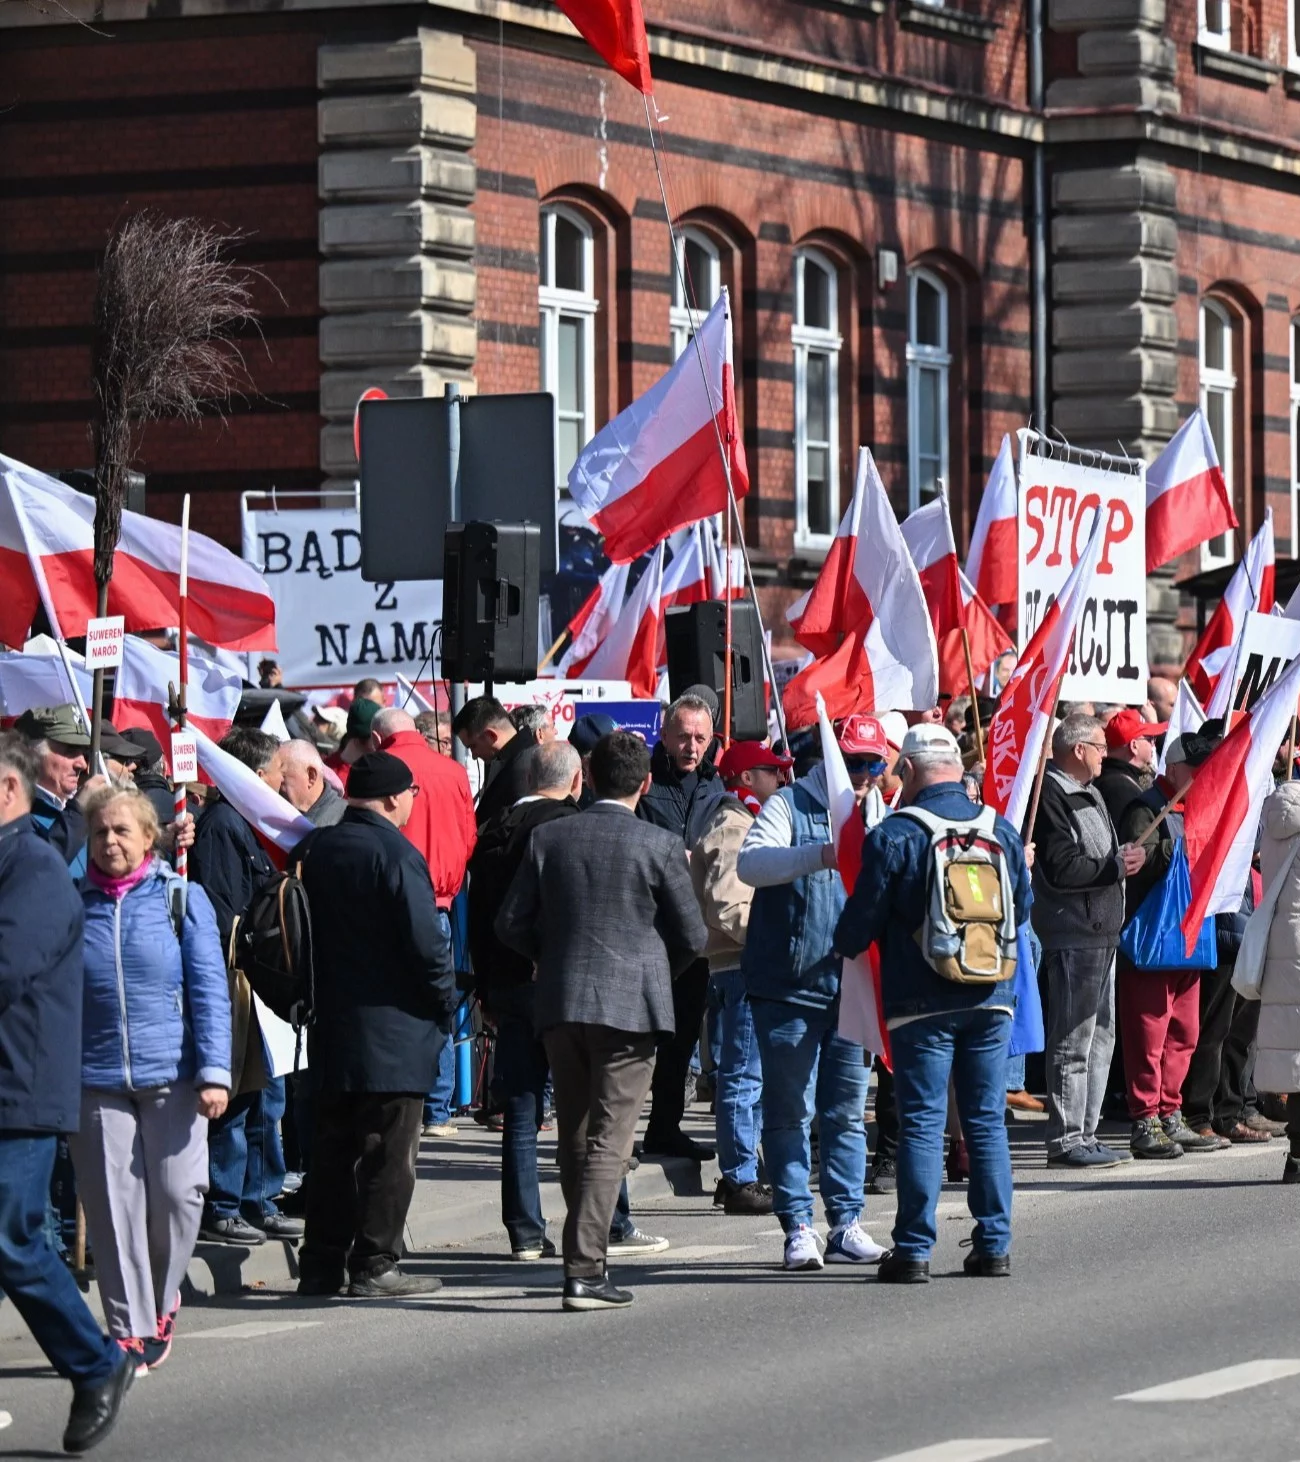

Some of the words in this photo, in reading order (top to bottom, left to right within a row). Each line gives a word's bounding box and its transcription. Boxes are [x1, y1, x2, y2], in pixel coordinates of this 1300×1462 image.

[1026, 485, 1134, 575] STOP
[258, 529, 362, 580] BĄD
[374, 581, 399, 611] Z
[89, 628, 123, 641] SUWEREN
[173, 743, 196, 755] SUWEREN
